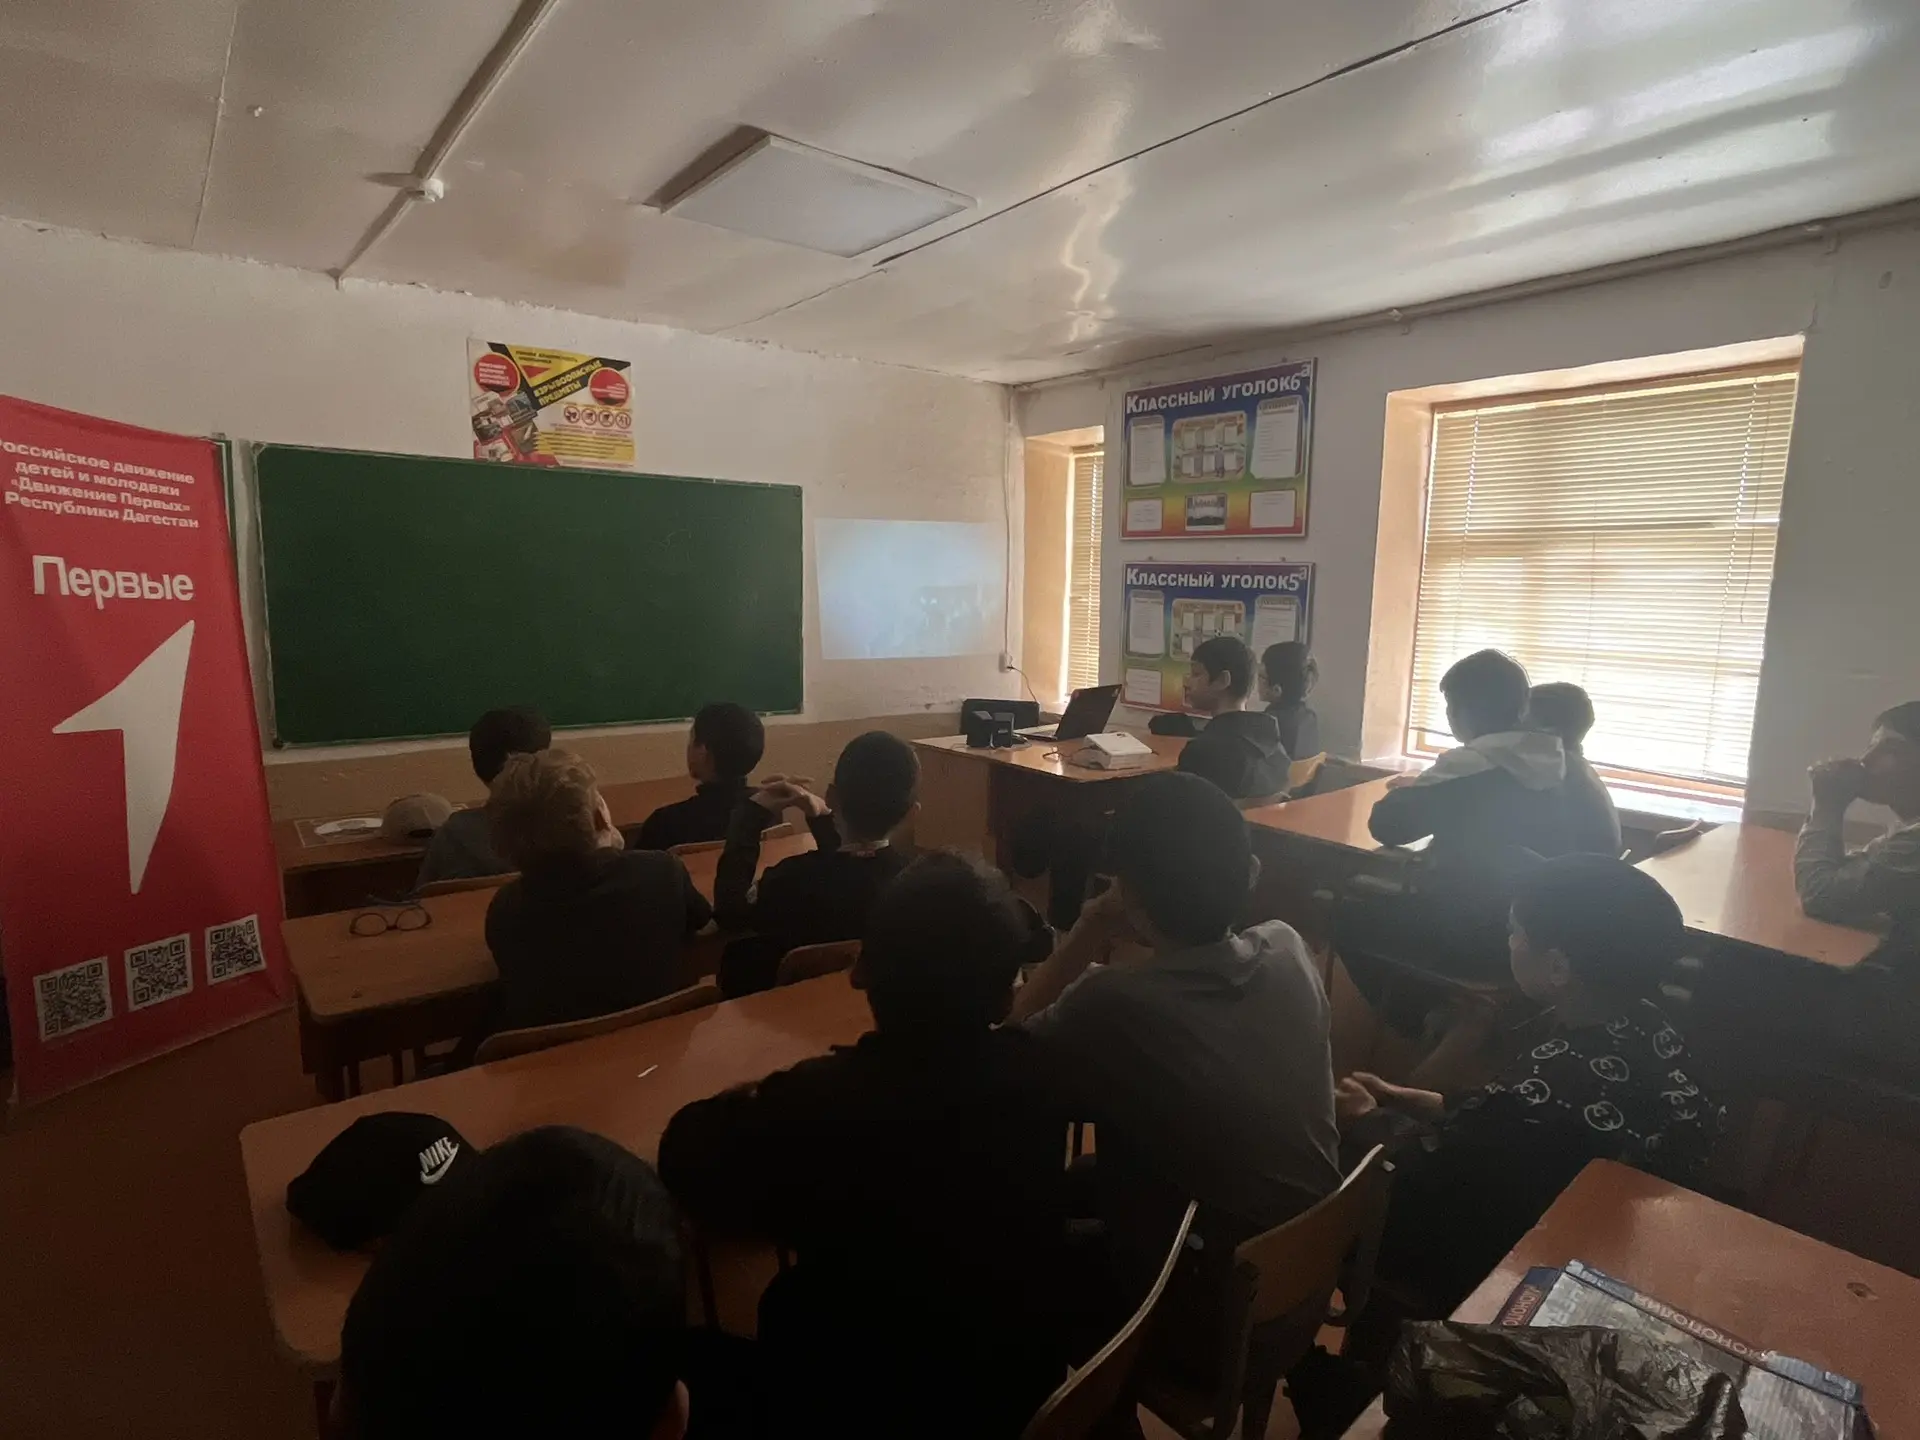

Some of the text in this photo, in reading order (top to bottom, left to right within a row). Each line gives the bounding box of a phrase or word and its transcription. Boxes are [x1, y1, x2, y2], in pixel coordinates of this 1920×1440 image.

[15, 461, 180, 497] детей и молодежи
[113, 462, 195, 484] движение
[4, 491, 199, 528] Республики Дагестан
[10, 477, 190, 512] «Движение Первых»
[32, 555, 194, 610] Первые
[419, 1137, 453, 1173] NIKE
